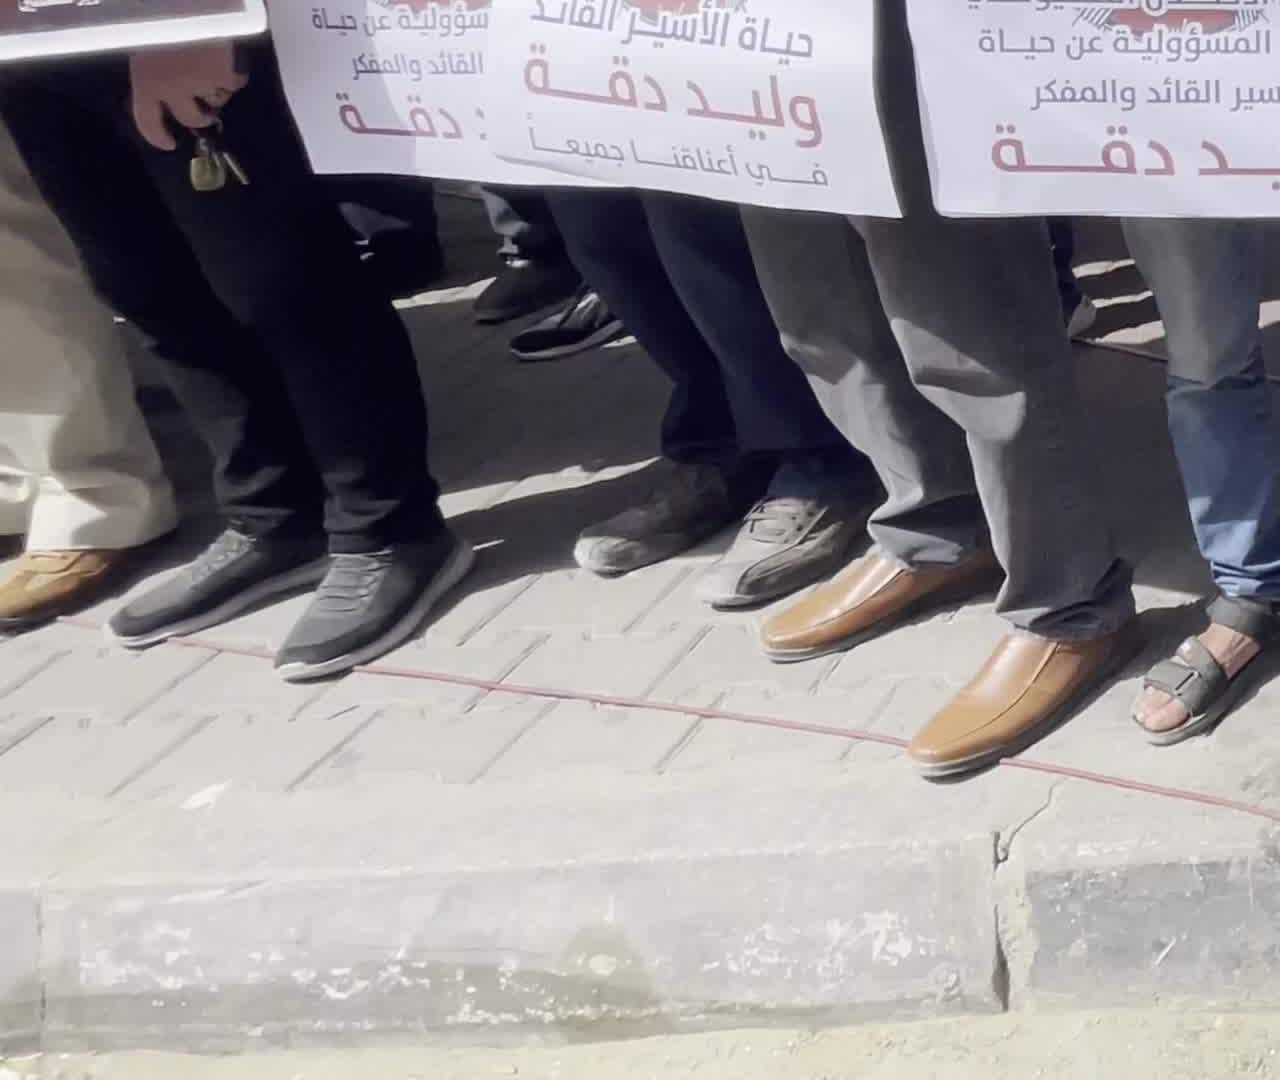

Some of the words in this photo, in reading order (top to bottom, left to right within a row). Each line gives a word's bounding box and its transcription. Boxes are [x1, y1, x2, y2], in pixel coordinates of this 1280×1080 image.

[312, 8, 358, 37] حياة
[363, 12, 392, 38] عن
[738, 16, 814, 66] حياة
[977, 29, 1056, 61] حياة
[1065, 37, 1105, 61] عن
[1113, 24, 1271, 62] المسؤولية
[352, 52, 423, 82] والمفكر
[427, 50, 484, 75] القائد
[523, 42, 668, 113] دقة
[1030, 78, 1137, 111] والمفكر
[1145, 75, 1221, 105] القائد
[335, 92, 463, 140] دقة
[686, 73, 824, 149] وليد
[630, 138, 739, 177] أعناقنا
[991, 123, 1176, 177] دقة
[746, 163, 829, 187] في
